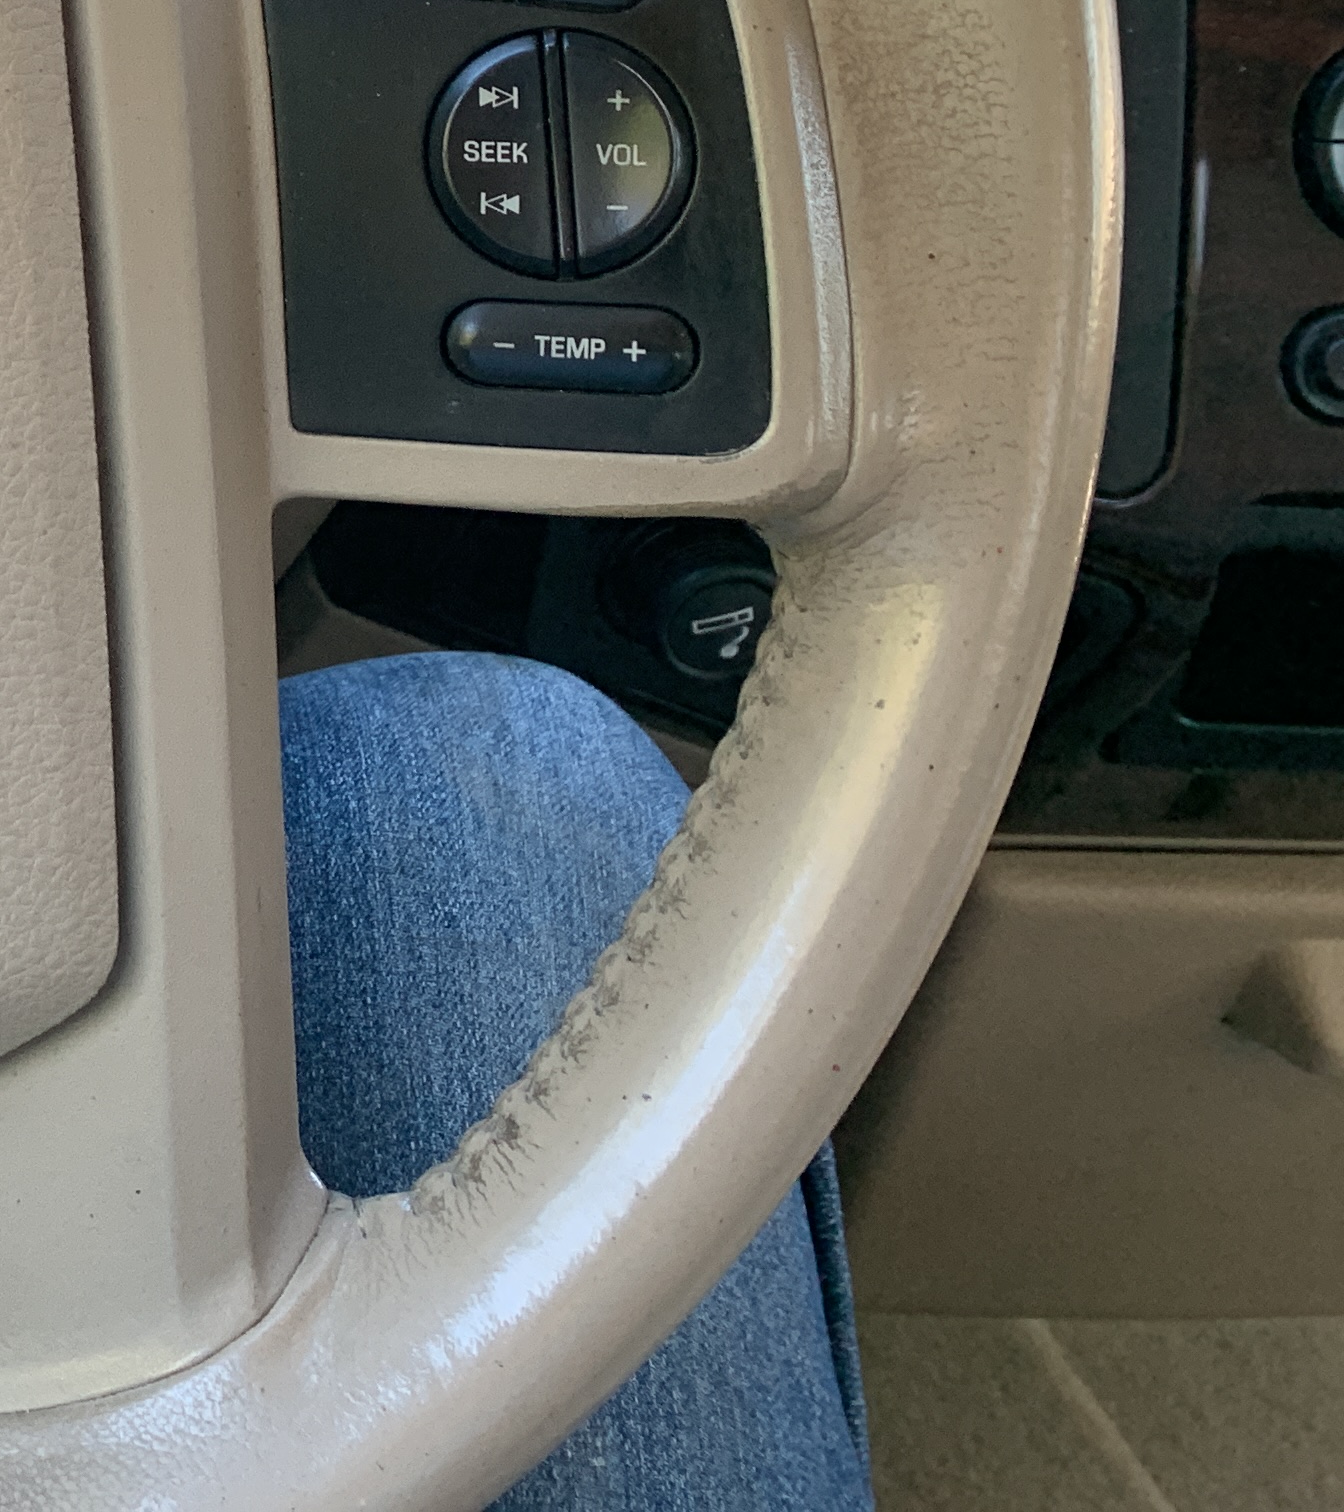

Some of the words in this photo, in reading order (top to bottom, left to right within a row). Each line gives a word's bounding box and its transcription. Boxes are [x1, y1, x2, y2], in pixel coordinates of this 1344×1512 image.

[463, 141, 528, 164] SEEK
[596, 143, 647, 168] VOL
[534, 335, 607, 361] TEMP
